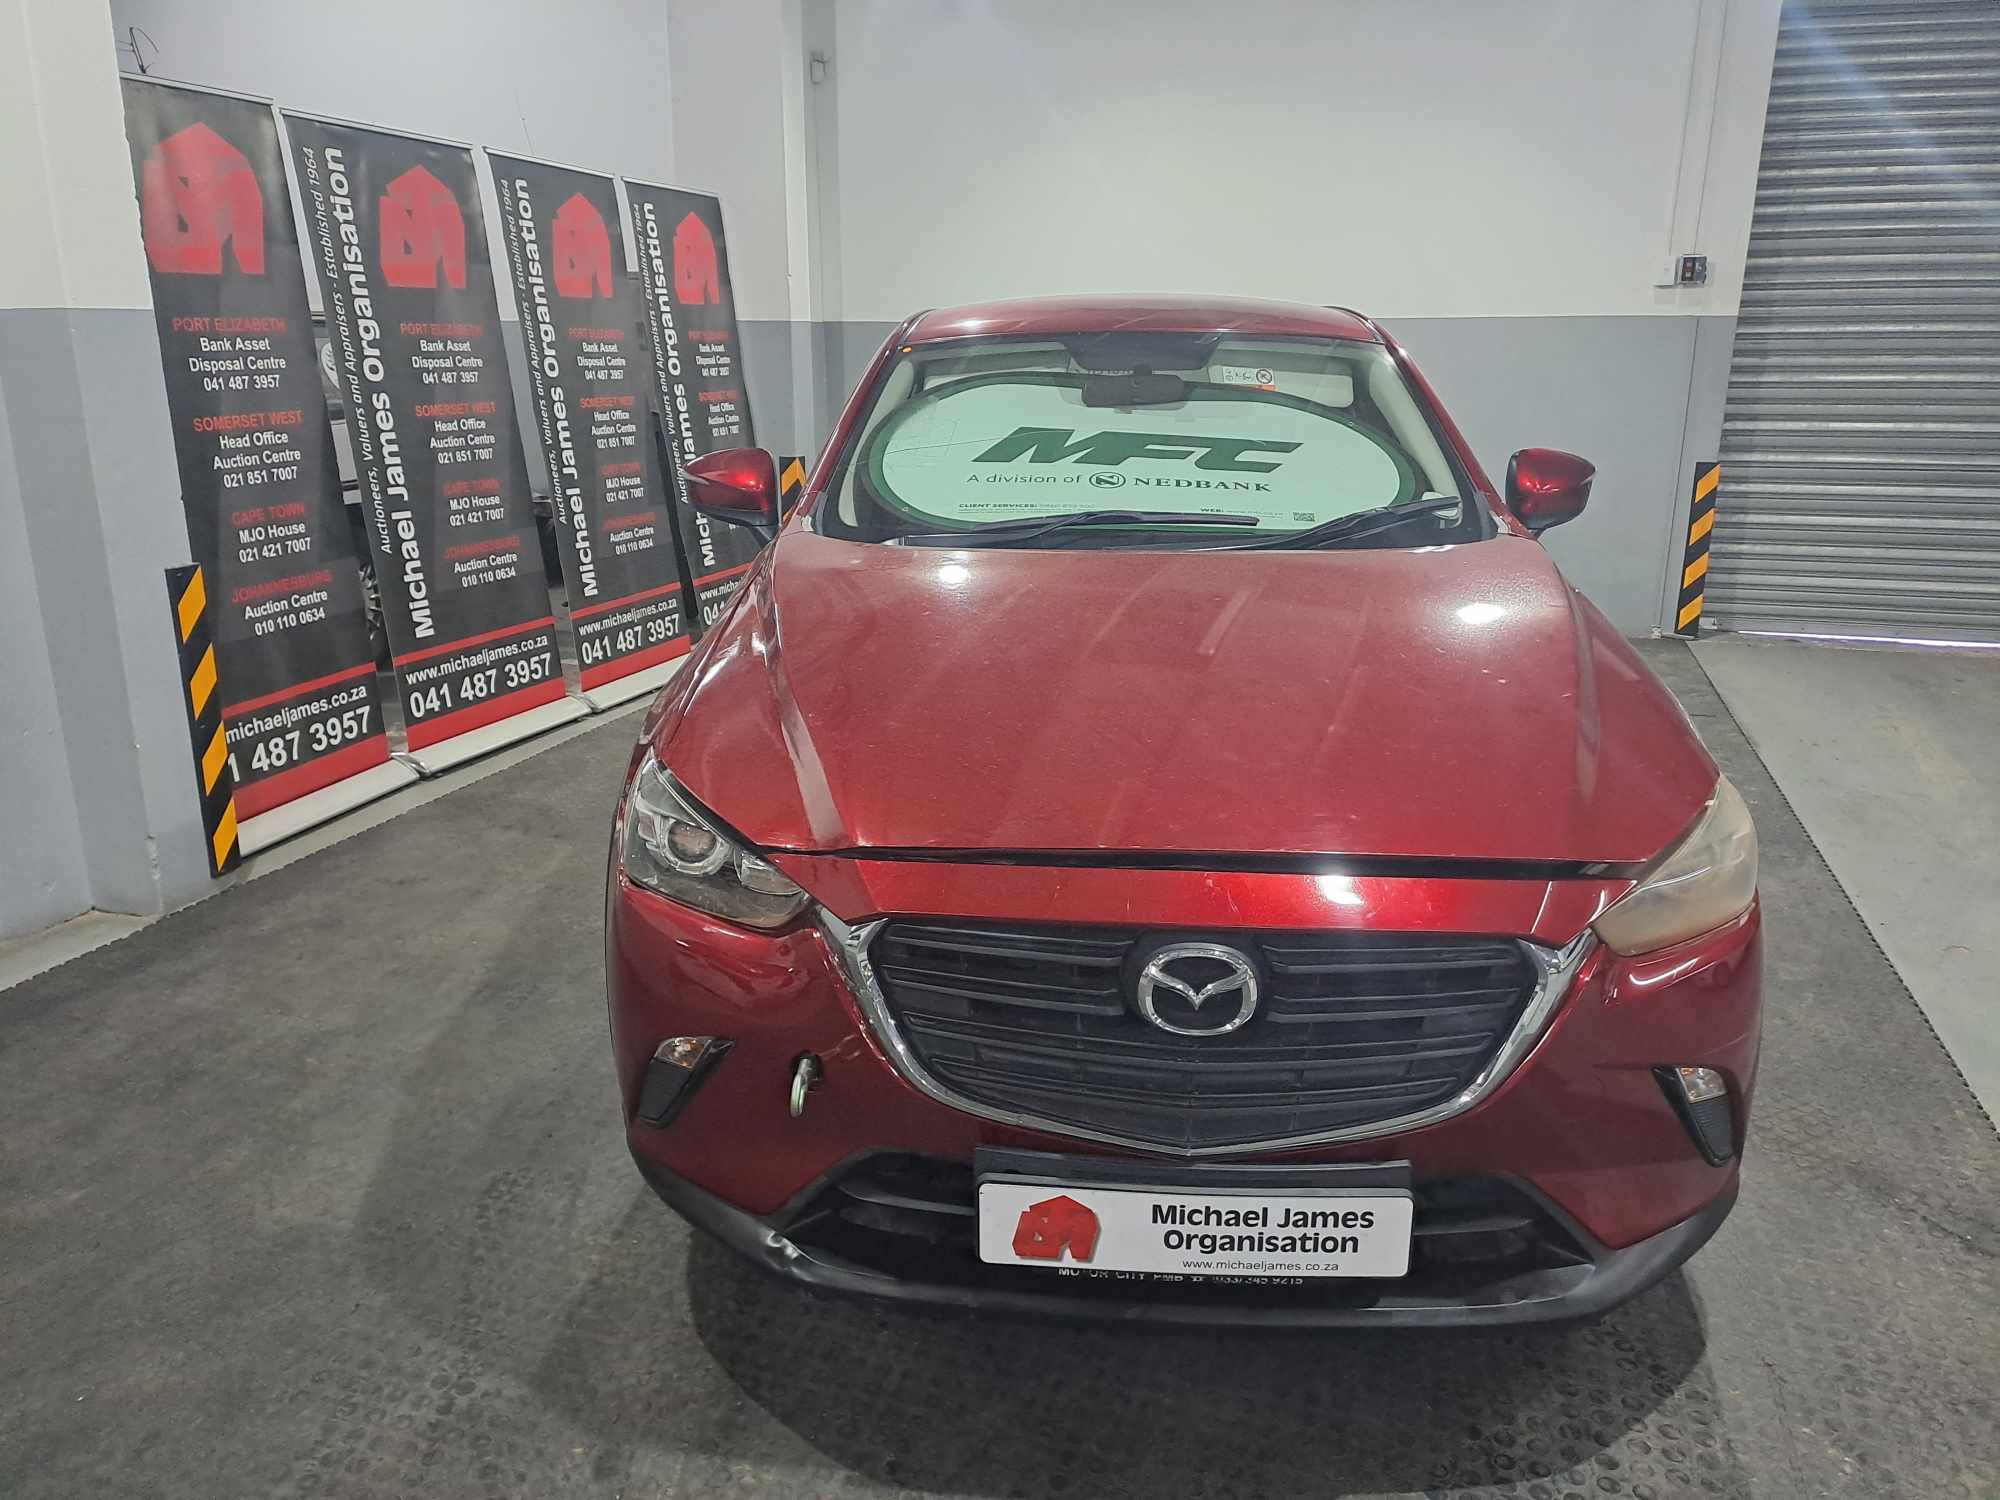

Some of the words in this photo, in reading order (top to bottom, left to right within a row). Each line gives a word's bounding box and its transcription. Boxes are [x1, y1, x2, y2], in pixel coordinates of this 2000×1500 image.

[302, 146, 320, 186] 1964
[310, 188, 339, 279] Established
[325, 147, 385, 382] Organisation
[515, 178, 559, 379] Organisation
[644, 203, 681, 377] Organisation
[173, 318, 209, 332] PORT
[332, 291, 358, 371] Appraisers
[522, 301, 541, 369] Appraisers
[200, 337, 232, 351] Bank
[235, 336, 270, 351] Asset
[420, 340, 445, 351] Bank
[447, 340, 471, 351] Asset
[189, 357, 244, 373] Disposal
[247, 356, 286, 370] Centre
[411, 356, 454, 370] Disposal
[455, 355, 483, 368] Centre
[203, 377, 224, 391] 041
[229, 376, 249, 390] 487
[254, 374, 280, 388] 3957
[346, 374, 363, 404] and
[422, 373, 439, 384] 041
[441, 372, 457, 384] 487
[460, 371, 479, 383] 3957
[533, 370, 545, 396] and
[193, 413, 264, 431] SOMERSET
[271, 410, 302, 426] WEST
[355, 407, 374, 460] Valuers
[434, 420, 459, 432] Head
[460, 418, 486, 430] Office
[539, 398, 553, 446] Valuers
[551, 387, 578, 481] James
[219, 434, 250, 449] Head
[253, 431, 288, 446] Office
[371, 392, 408, 501] James
[430, 437, 466, 449] Auction
[467, 433, 496, 445] Centre
[970, 426, 1303, 474] MFC
[213, 454, 260, 470] Auction
[263, 449, 300, 463] Centre
[438, 452, 453, 465] 021
[456, 450, 472, 463] 851
[473, 448, 493, 461] 7007
[223, 474, 243, 488] 021
[247, 470, 268, 485] 851
[271, 466, 297, 481] 7007
[548, 449, 568, 525] Auctioneers,
[966, 474, 979, 483] A
[985, 473, 1057, 484] division
[1063, 472, 1084, 484] of
[1132, 477, 1272, 493] NEDBANK
[367, 467, 392, 553] Auctioneers,
[450, 498, 470, 511] MJO
[472, 495, 500, 508] House
[450, 514, 465, 527] 021
[467, 511, 483, 524] 421
[486, 508, 505, 521] 7007
[239, 527, 265, 544] MJO
[268, 523, 306, 539] House
[566, 488, 598, 597] Michael
[239, 547, 259, 563] 021
[262, 543, 283, 558] 421
[285, 537, 310, 554] 7007
[454, 559, 488, 574] Auction
[490, 553, 518, 567] Centre
[390, 510, 435, 639] Michael
[461, 576, 478, 588] 010
[479, 571, 495, 584] 110
[495, 567, 517, 581] 0634
[244, 600, 288, 619] Auction
[291, 590, 328, 608] Centre
[255, 619, 275, 636] 010
[276, 614, 297, 631] 110
[299, 607, 326, 625] 0634
[581, 635, 612, 665] 041
[616, 625, 642, 652] 487
[646, 613, 680, 642] 3957
[405, 635, 548, 685] www.michaeljames.co.za
[410, 683, 453, 718] 041
[460, 668, 497, 701] 487
[504, 652, 551, 688] 3957
[251, 731, 300, 771] 487
[309, 705, 370, 751] 3957
[1151, 1204, 1269, 1229] Michael
[1276, 1207, 1375, 1230] James
[1163, 1229, 1360, 1257] Organisation
[1182, 1259, 1339, 1273] www.michaeljames.co.za
